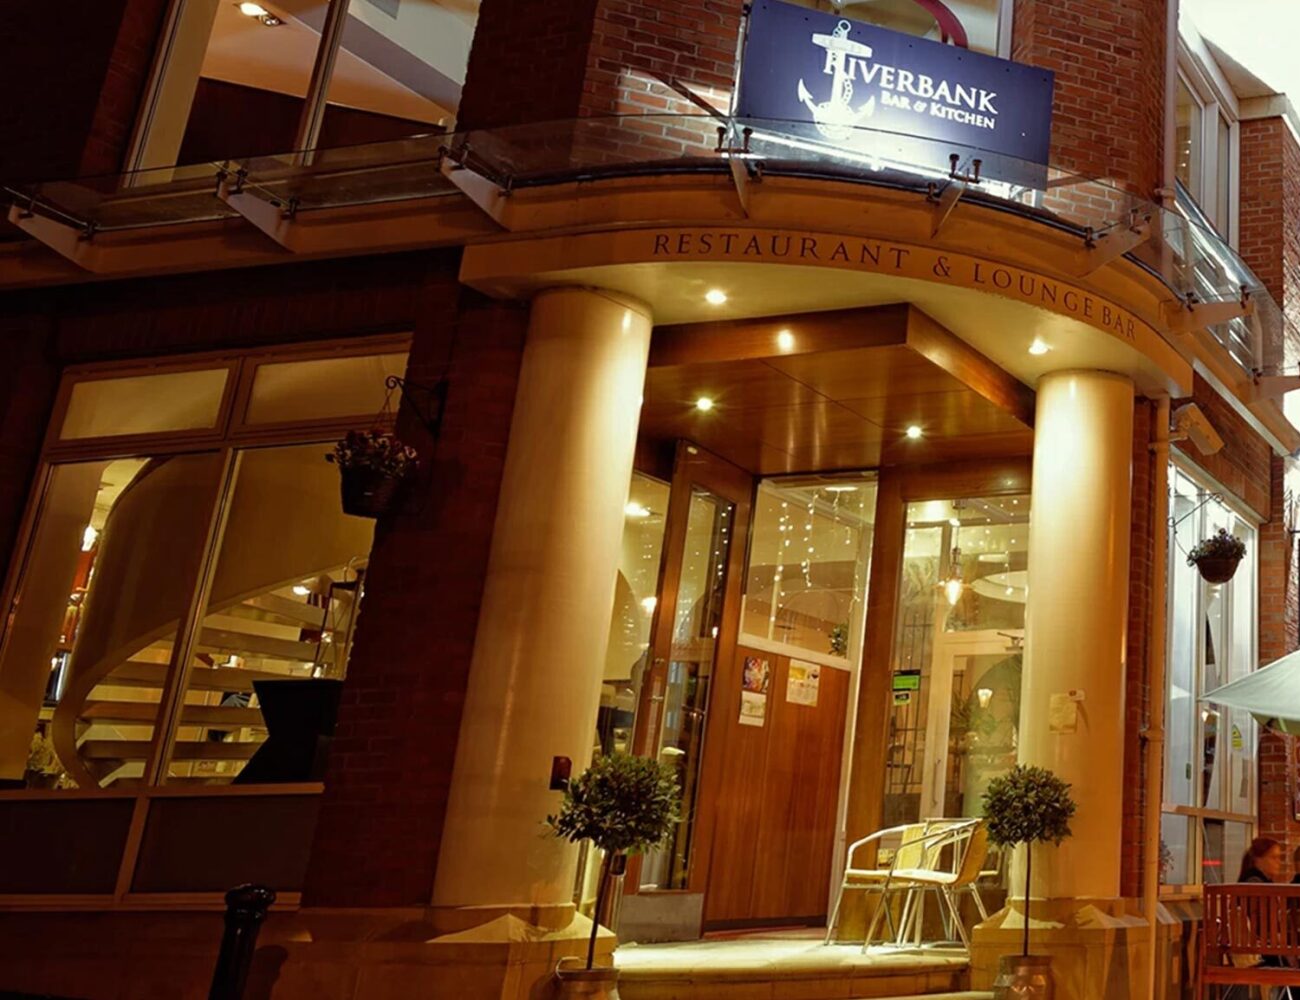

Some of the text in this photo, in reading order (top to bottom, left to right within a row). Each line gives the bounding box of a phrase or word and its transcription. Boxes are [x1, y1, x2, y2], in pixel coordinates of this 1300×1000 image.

[823, 49, 998, 114] RIVERBANK
[880, 90, 910, 110] BAR
[930, 101, 995, 129] KITCHEN
[653, 233, 1137, 341] RESTAURANT & LOUNGE BAR
